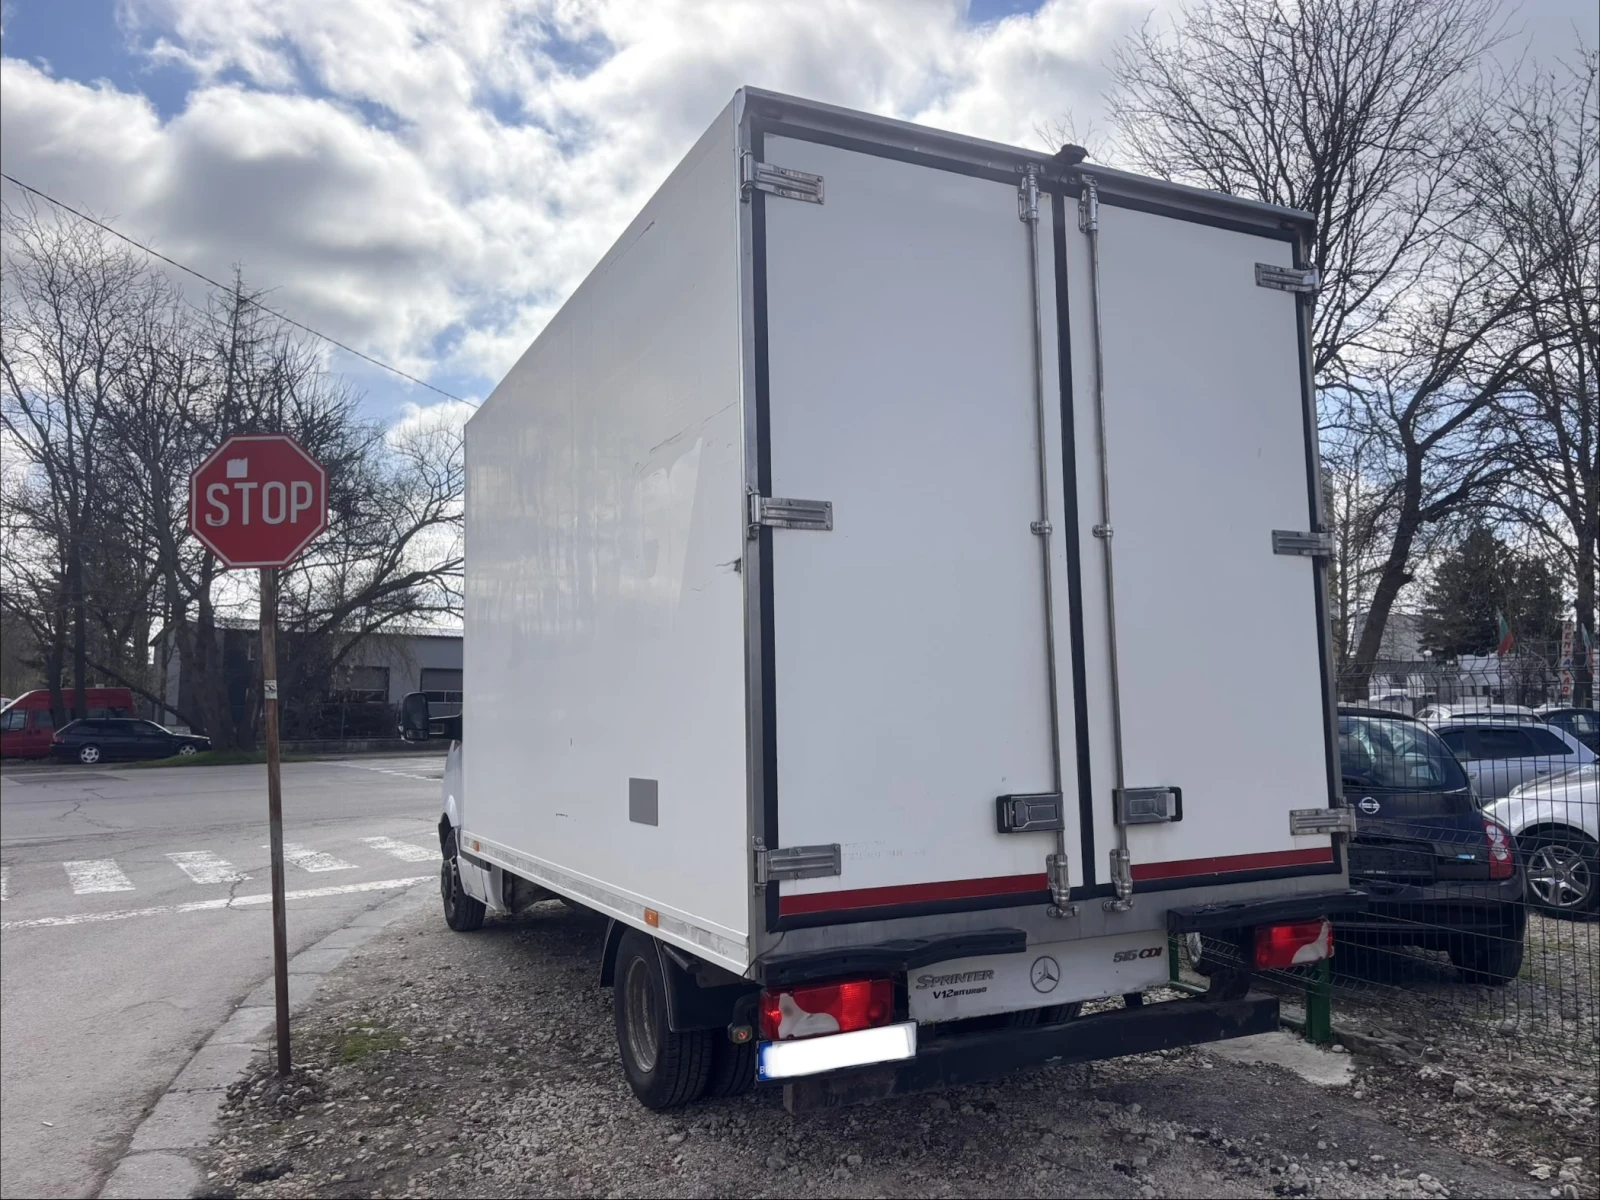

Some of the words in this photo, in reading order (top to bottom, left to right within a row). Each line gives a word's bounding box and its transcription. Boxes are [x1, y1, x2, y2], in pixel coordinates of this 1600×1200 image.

[205, 481, 313, 527] STOP
[1563, 623, 1573, 658] RENT
[1562, 668, 1571, 693] CAR
[1113, 949, 1138, 963] 515
